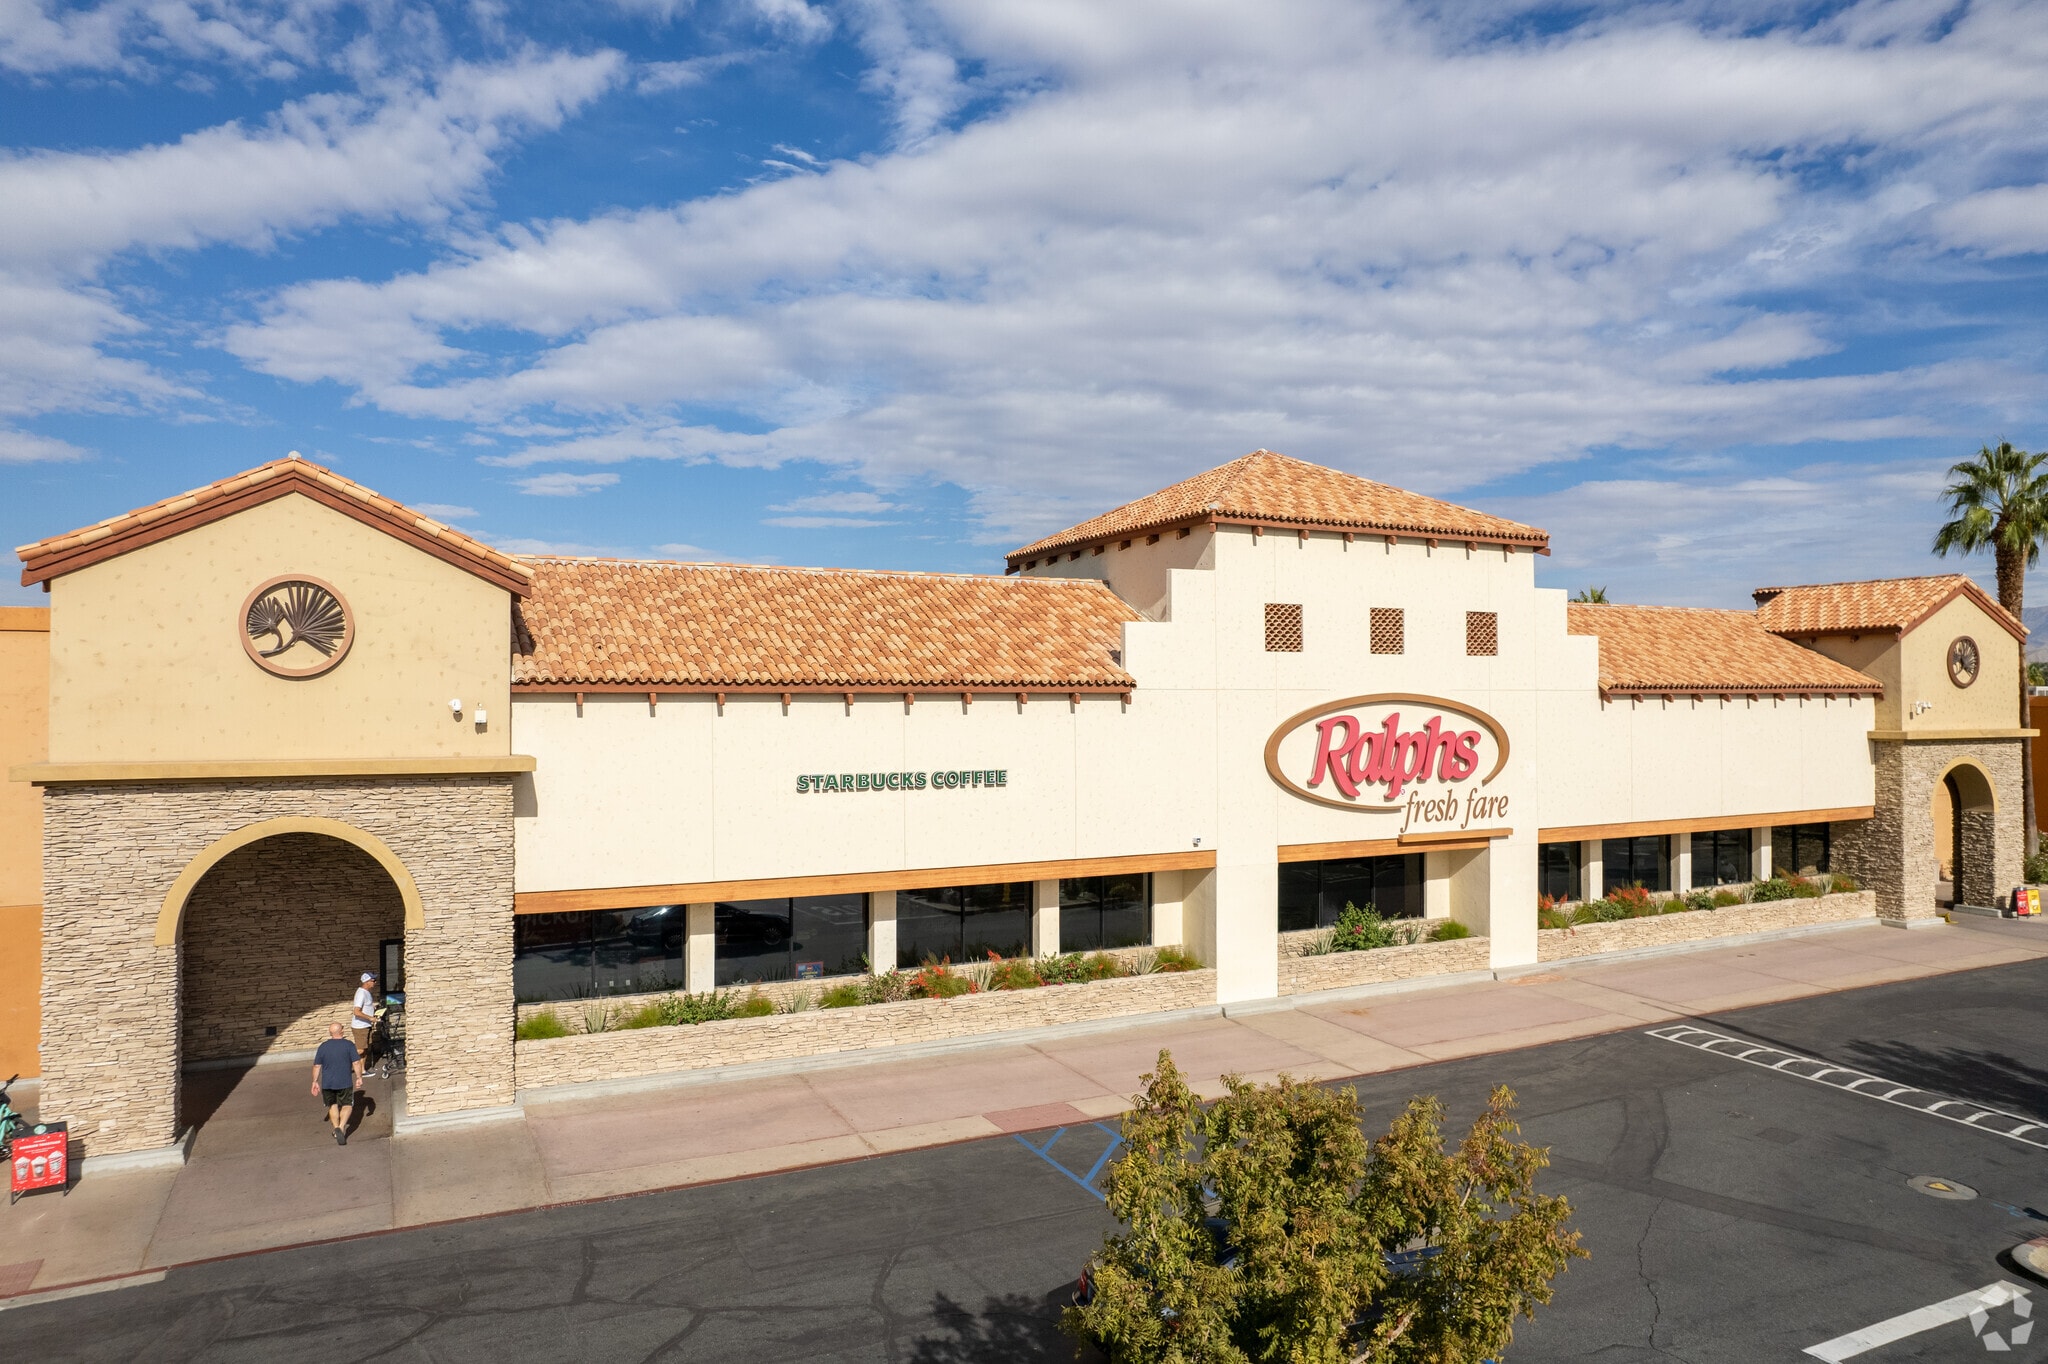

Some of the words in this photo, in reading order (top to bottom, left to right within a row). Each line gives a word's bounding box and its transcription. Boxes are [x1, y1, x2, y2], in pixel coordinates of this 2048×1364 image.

[1308, 712, 1481, 799] Ralphs
[797, 772, 927, 792] STARBUCKS
[932, 770, 1008, 788] COFFEE
[1401, 789, 1458, 833] fresh
[1461, 787, 1509, 829] fare
[520, 911, 592, 926] PICKUP
